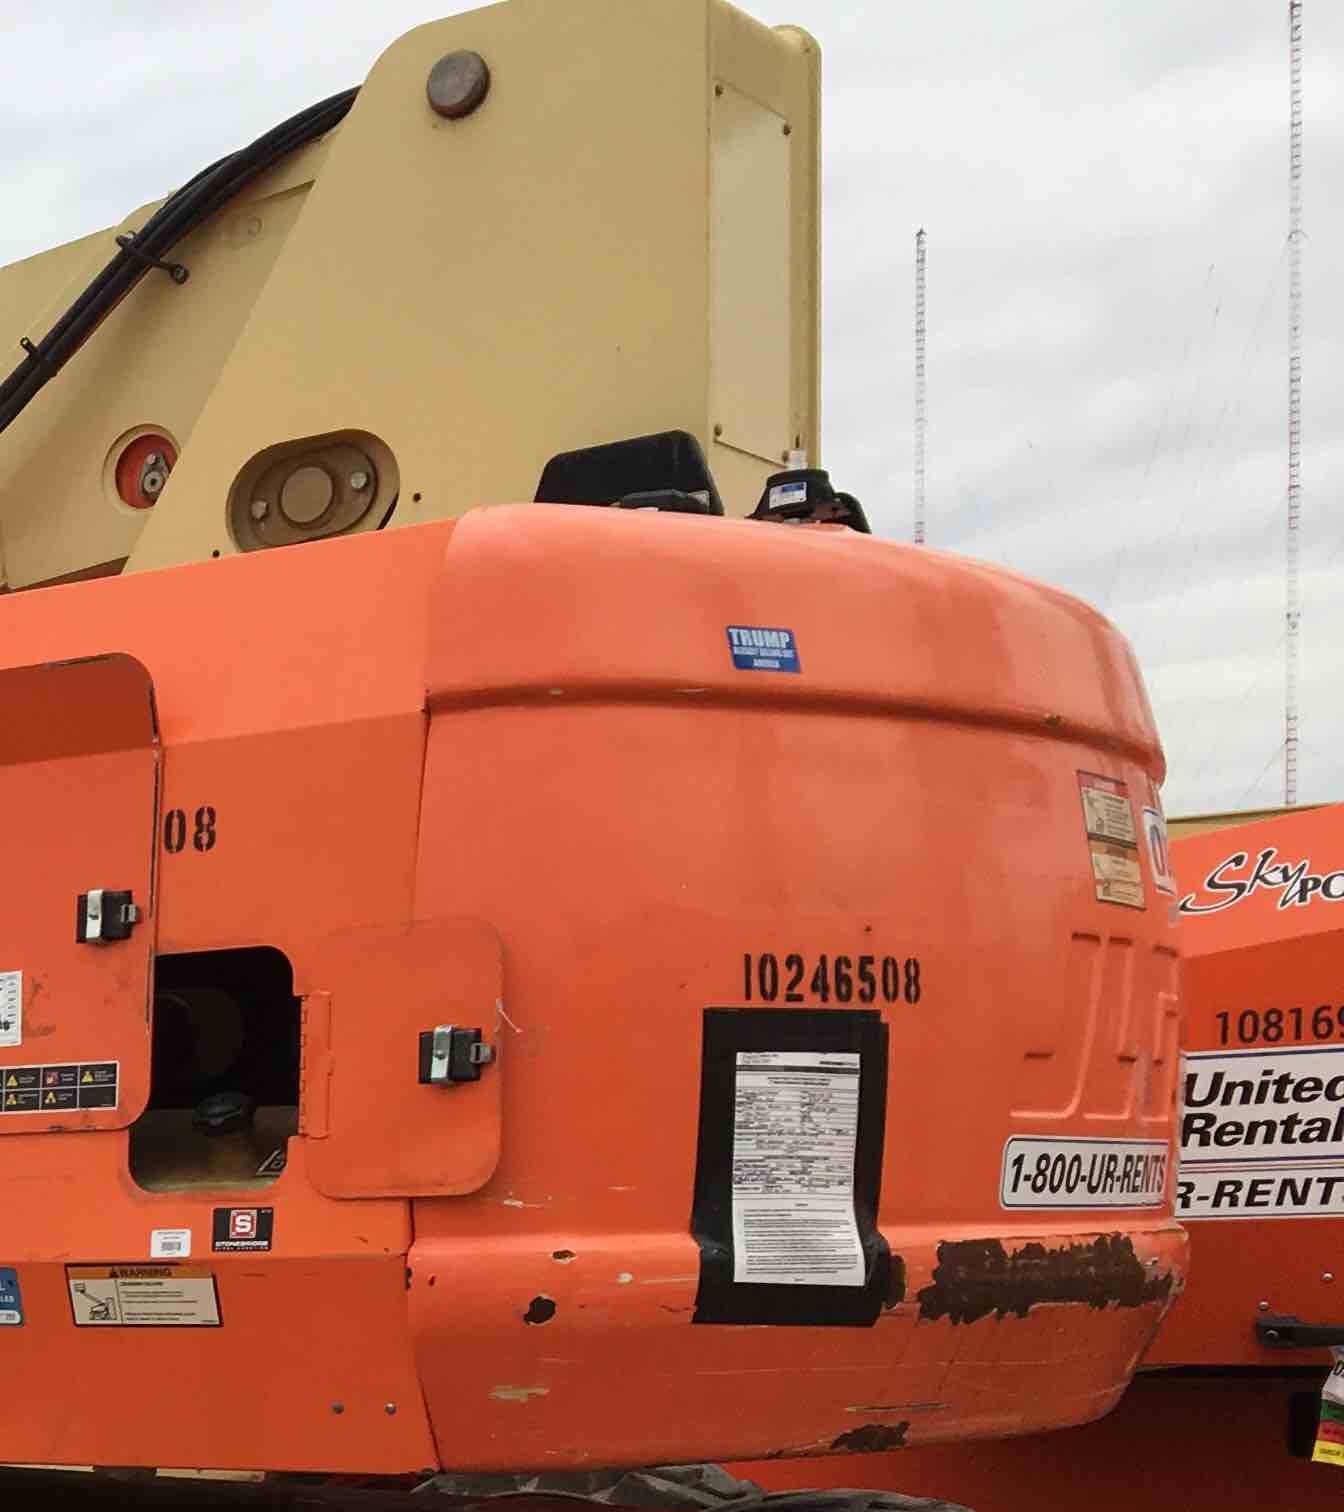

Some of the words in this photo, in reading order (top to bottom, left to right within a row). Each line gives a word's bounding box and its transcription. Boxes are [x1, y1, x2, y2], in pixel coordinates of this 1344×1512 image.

[728, 628, 790, 648] TRUMP
[164, 806, 216, 853] 08
[1179, 849, 1308, 913] Sky
[744, 952, 921, 1004] 10246508
[1011, 1152, 1165, 1194] 1-800-UR-RENTS
[117, 1267, 172, 1279] WARNING
